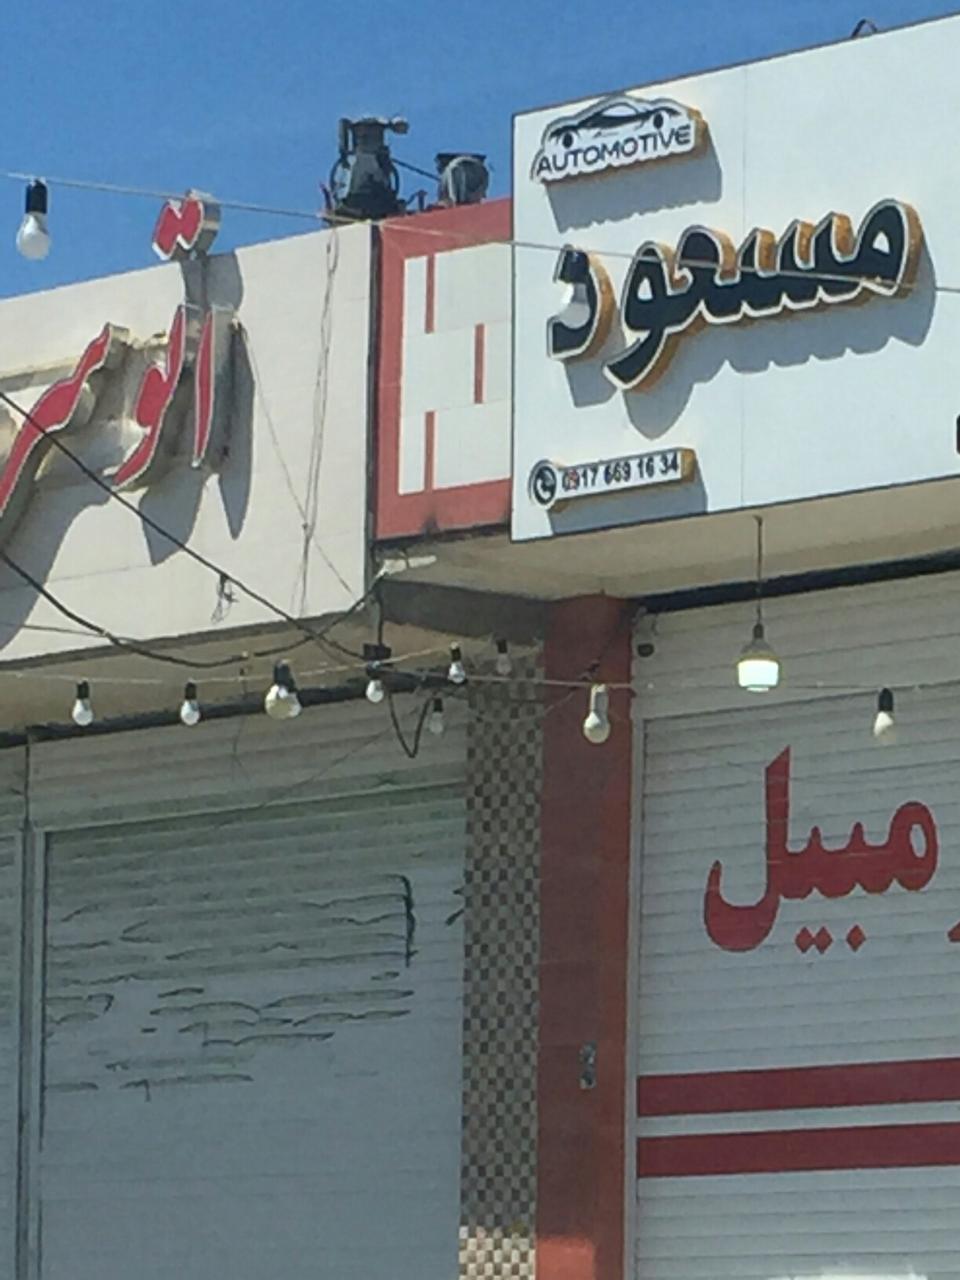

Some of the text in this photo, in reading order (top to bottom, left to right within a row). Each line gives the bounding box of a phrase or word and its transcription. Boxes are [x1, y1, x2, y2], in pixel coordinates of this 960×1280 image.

[536, 123, 692, 177] AUTOMOTIVE
[547, 199, 908, 390] مسعود
[562, 466, 599, 493] 0917
[660, 451, 679, 475] 34
